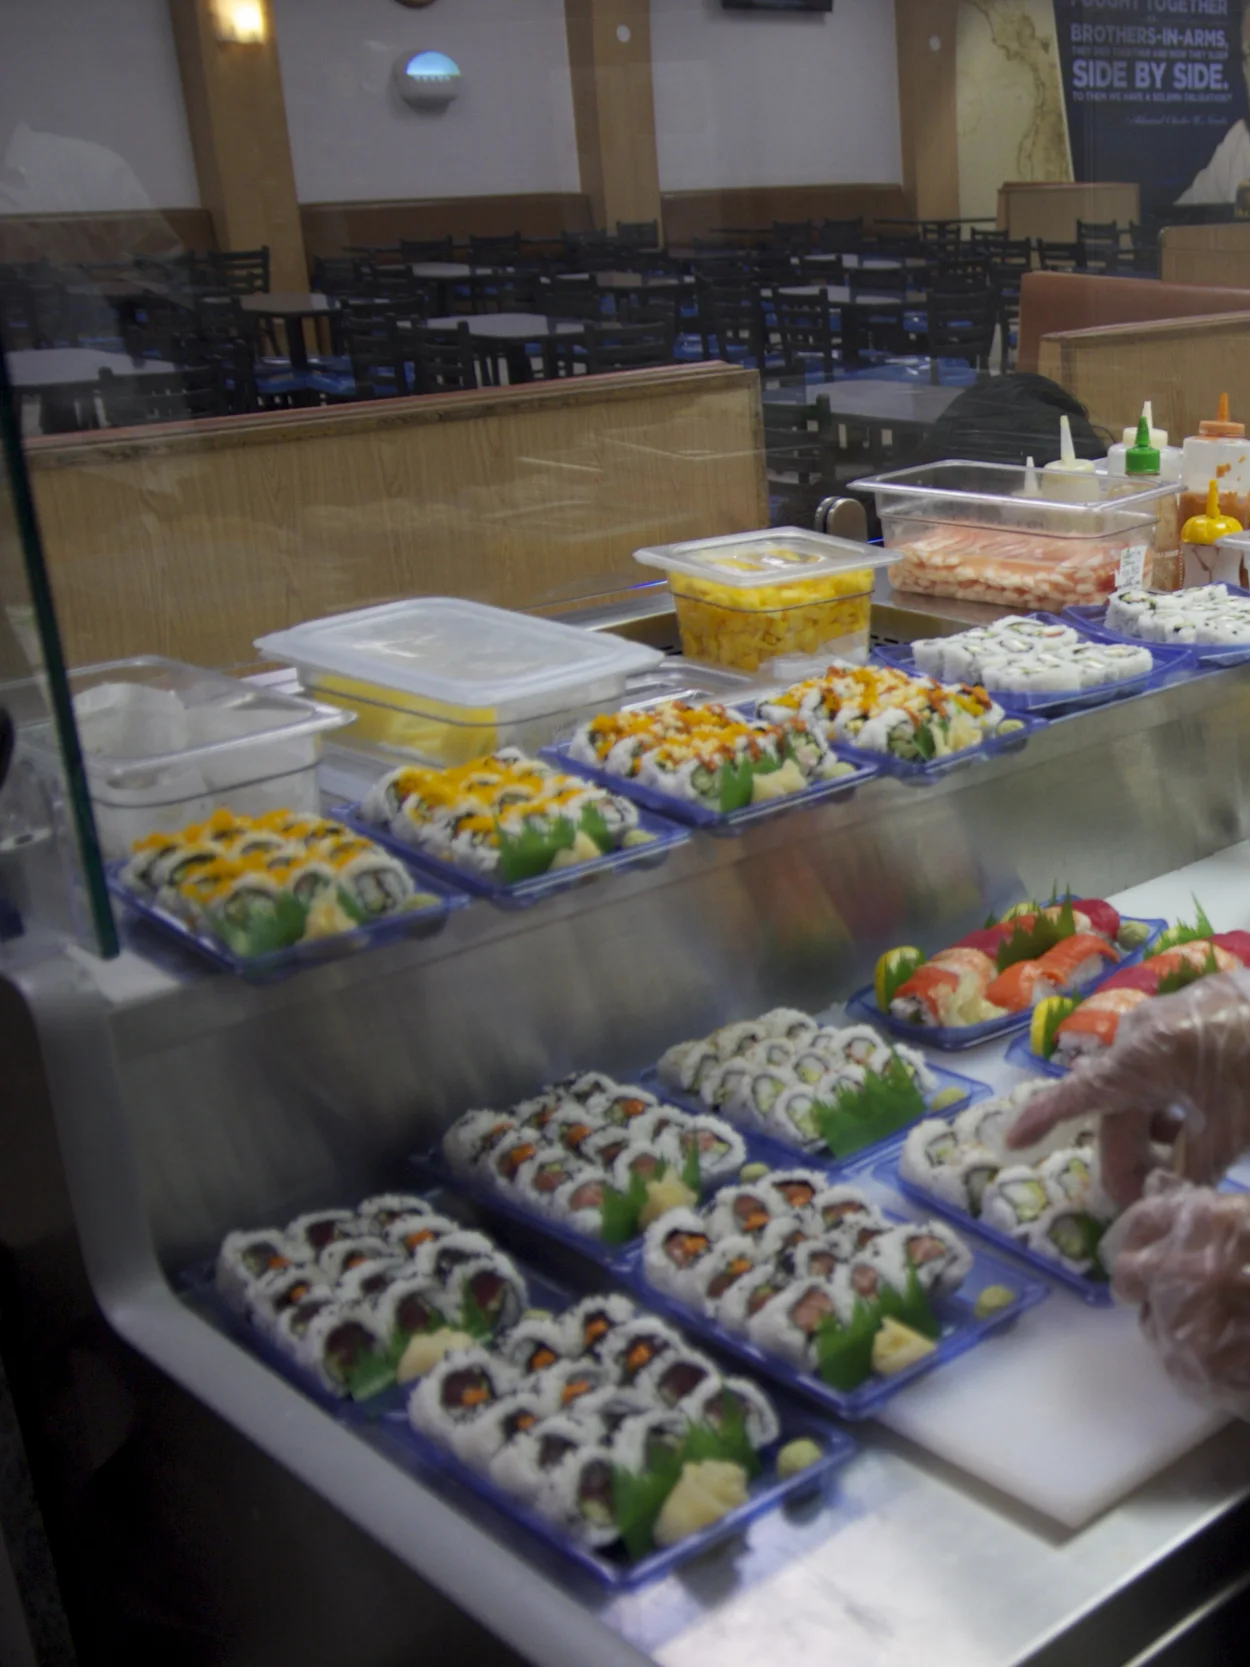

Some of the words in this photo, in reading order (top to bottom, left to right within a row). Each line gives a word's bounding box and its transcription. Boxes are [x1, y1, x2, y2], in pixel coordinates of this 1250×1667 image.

[1072, 58, 1128, 89] SIDE
[1134, 60, 1167, 90] BY
[1173, 62, 1229, 91] SIDE.
